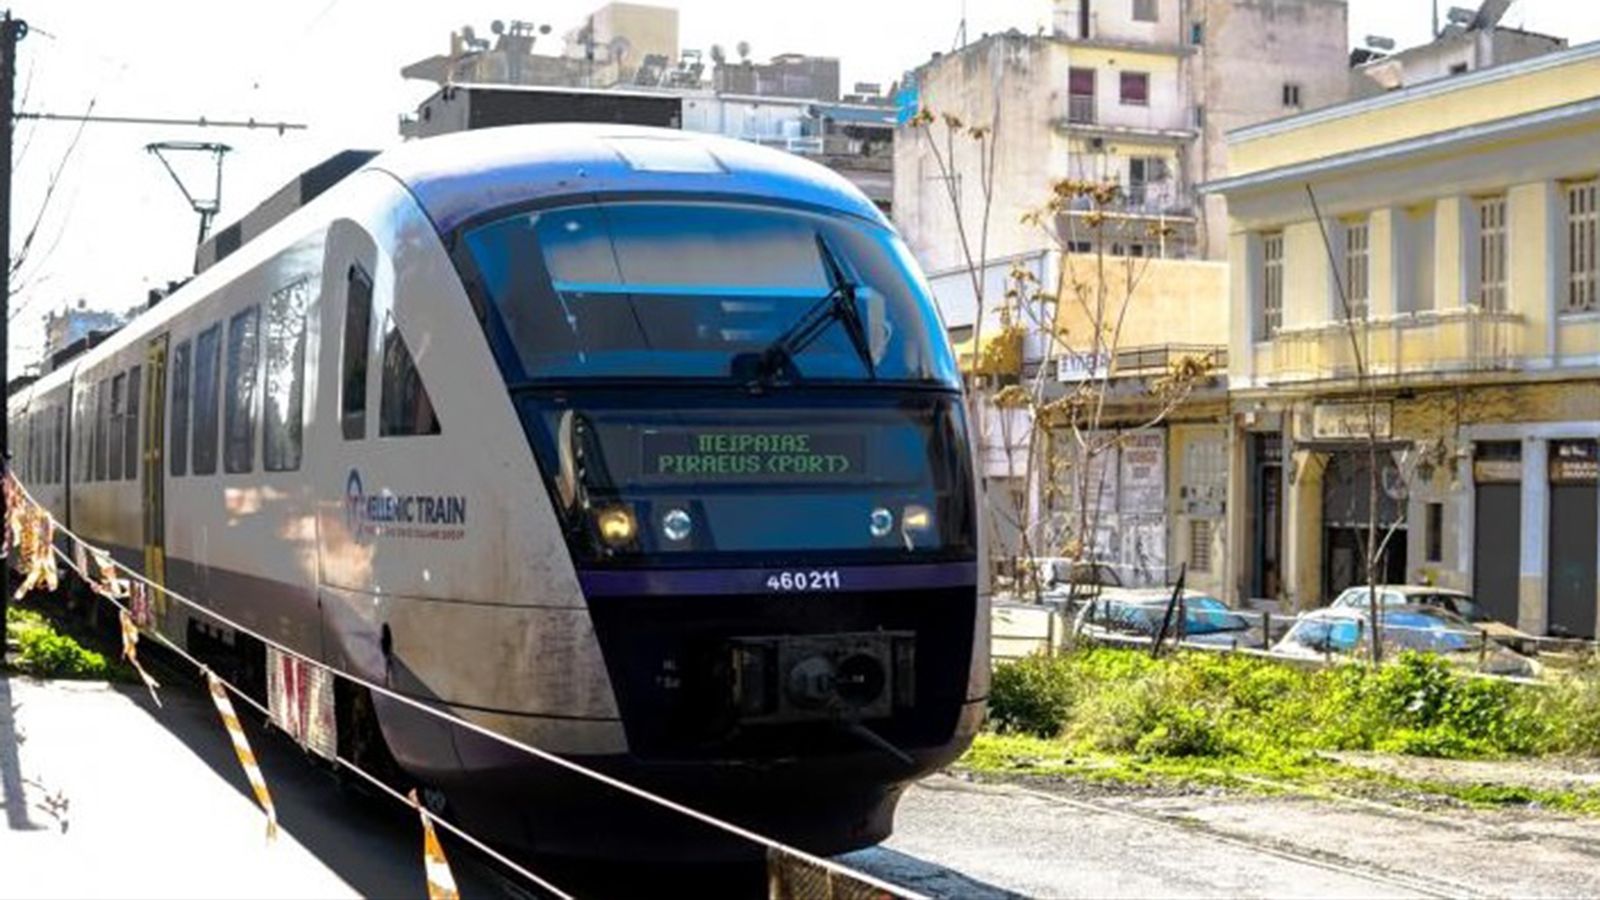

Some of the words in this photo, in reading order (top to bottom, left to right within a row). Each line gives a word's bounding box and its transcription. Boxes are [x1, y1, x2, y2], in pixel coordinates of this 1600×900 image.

[699, 434, 810, 452] ΠΕΙΡΑΙΑΣ
[658, 454, 761, 473] PIRAEUS
[416, 496, 466, 525] TRAIN
